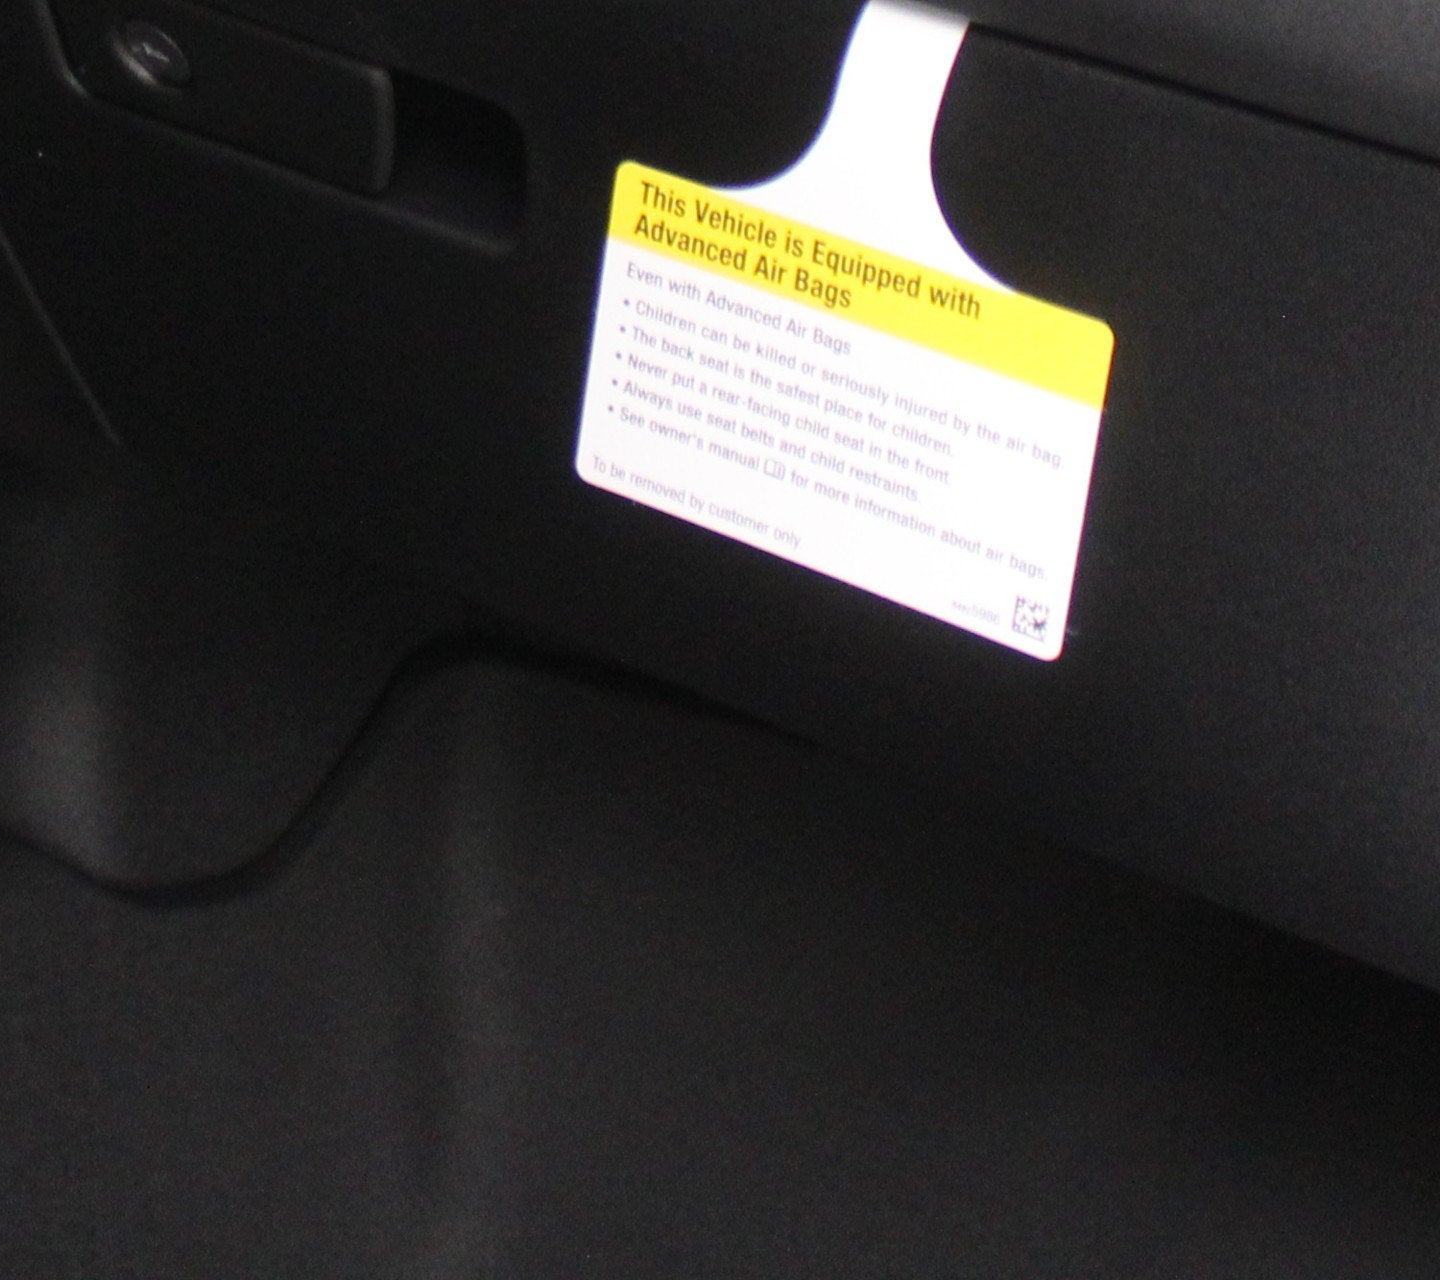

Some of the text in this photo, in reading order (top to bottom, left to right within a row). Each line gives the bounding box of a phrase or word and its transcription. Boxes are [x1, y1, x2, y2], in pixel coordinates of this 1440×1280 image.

[633, 213, 852, 308] Advanced Air Bags
[640, 179, 980, 319] This Vehicle is Equipped with
[625, 259, 851, 355] Even with Advanced Air Bags
[622, 378, 673, 410] Always
[676, 400, 703, 421] use
[705, 411, 737, 434] seat
[739, 421, 775, 448] belts
[778, 438, 807, 459] and
[809, 449, 846, 474] child
[626, 351, 668, 379] Never
[670, 370, 695, 390] put
[697, 380, 708, 395] a
[793, 415, 830, 439] child
[832, 429, 865, 452] seat
[867, 439, 883, 460] in
[886, 447, 910, 470] the
[632, 324, 657, 348] The
[660, 336, 694, 361] back
[698, 352, 729, 374] seat
[732, 361, 745, 380] is
[749, 367, 772, 390] the
[775, 380, 820, 408] safest
[822, 397, 863, 423] place
[866, 410, 887, 431] for
[634, 298, 697, 333] Children
[700, 325, 728, 346] can
[731, 332, 751, 353] be
[754, 341, 797, 370] killed
[799, 361, 817, 377] or
[820, 367, 890, 406] seriously
[893, 392, 949, 425] injured
[951, 413, 971, 436] by
[975, 422, 1001, 444] the
[1004, 435, 1026, 453] air
[592, 453, 607, 474] To
[609, 461, 626, 481] be
[628, 470, 686, 504] removed
[688, 491, 705, 513] by
[707, 501, 770, 534] customer
[619, 405, 645, 428] See
[707, 440, 760, 472] manual
[789, 467, 810, 489] for
[812, 479, 850, 505] more
[853, 492, 936, 537] information
[939, 528, 981, 555] about
[984, 546, 1004, 563] air
